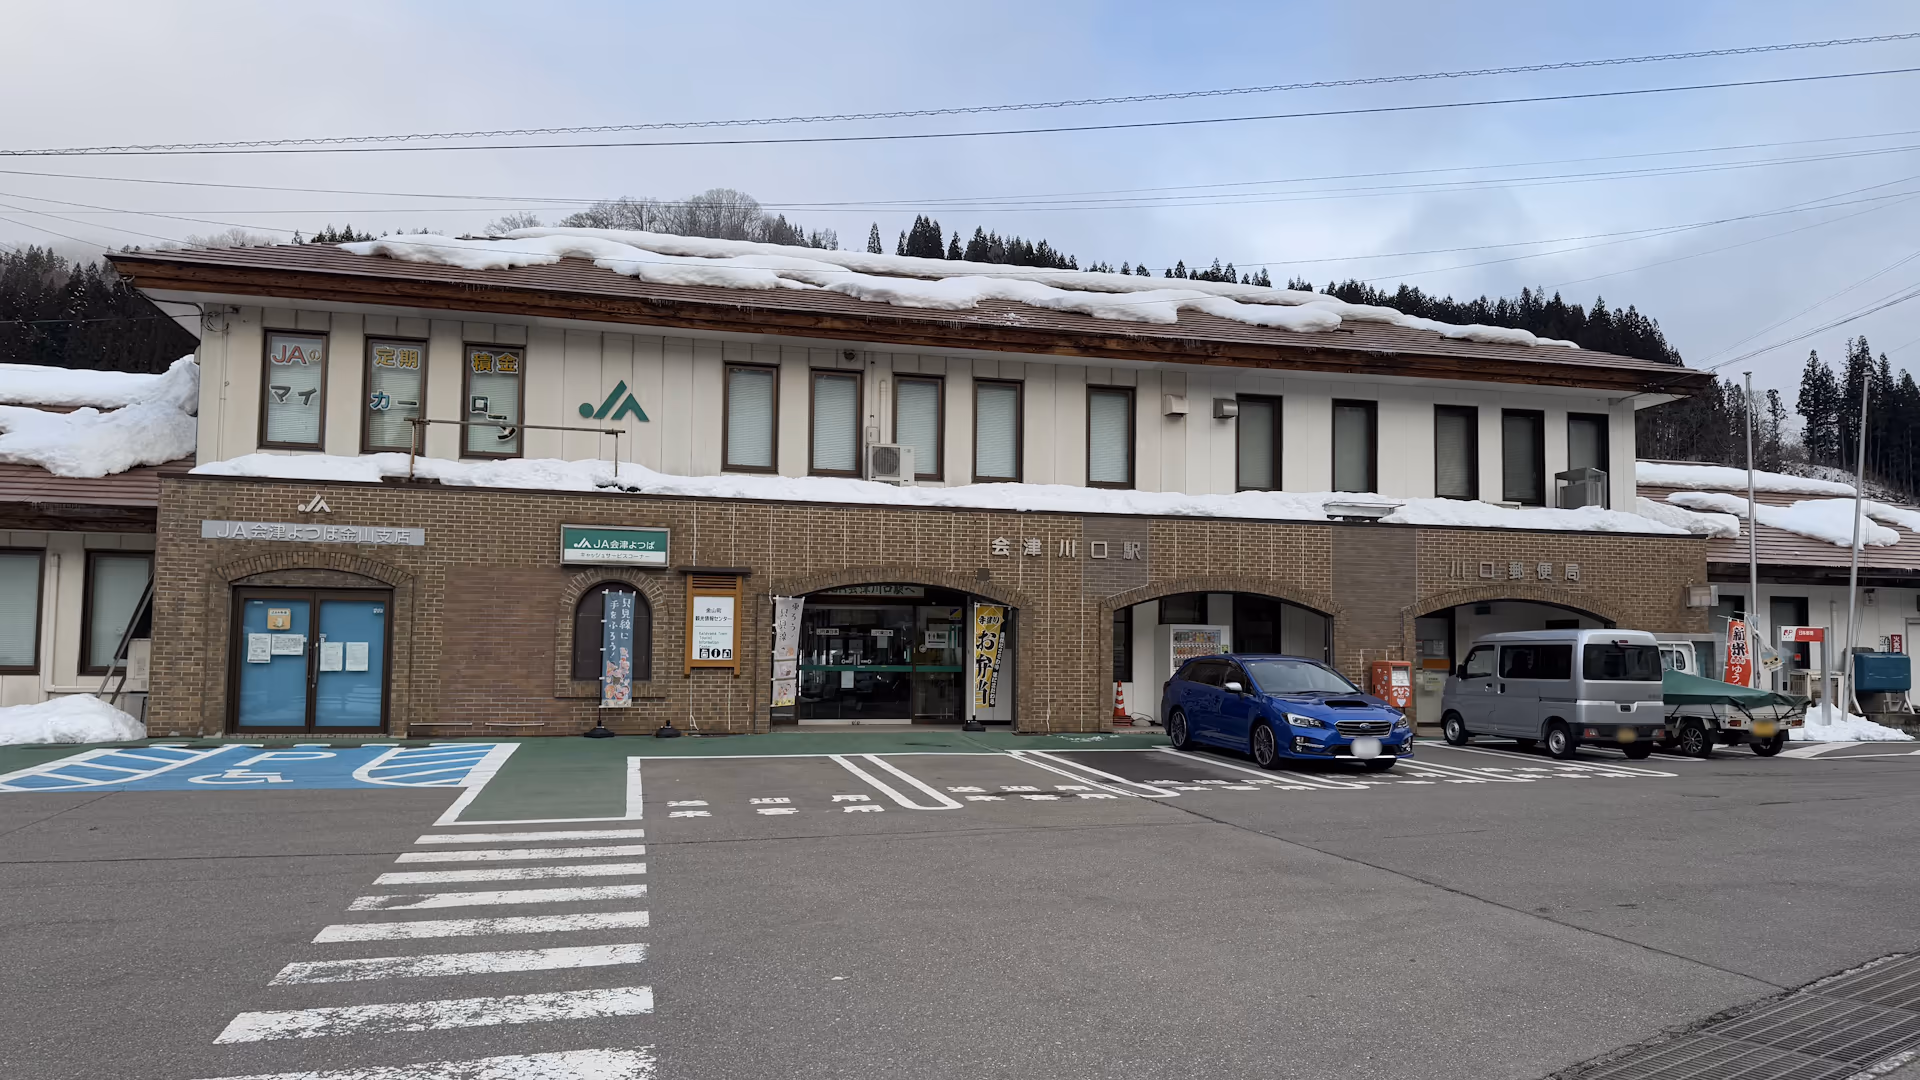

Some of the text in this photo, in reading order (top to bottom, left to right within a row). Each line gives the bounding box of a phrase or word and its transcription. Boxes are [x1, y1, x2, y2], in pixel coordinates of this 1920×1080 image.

[270, 344, 519, 373] JAの 定期 積金
[269, 384, 318, 405] マイ
[370, 390, 419, 411] カー
[215, 521, 411, 545] JA会津よつば金山支店
[593, 539, 656, 550] JA会津よつば
[990, 536, 1142, 561] 会津川口駅
[1450, 560, 1581, 582] 川口郵便局
[619, 597, 632, 640] 只見線に
[1731, 626, 1746, 657] 新米
[1731, 665, 1743, 686] ゆう
[233, 751, 337, 767] P
